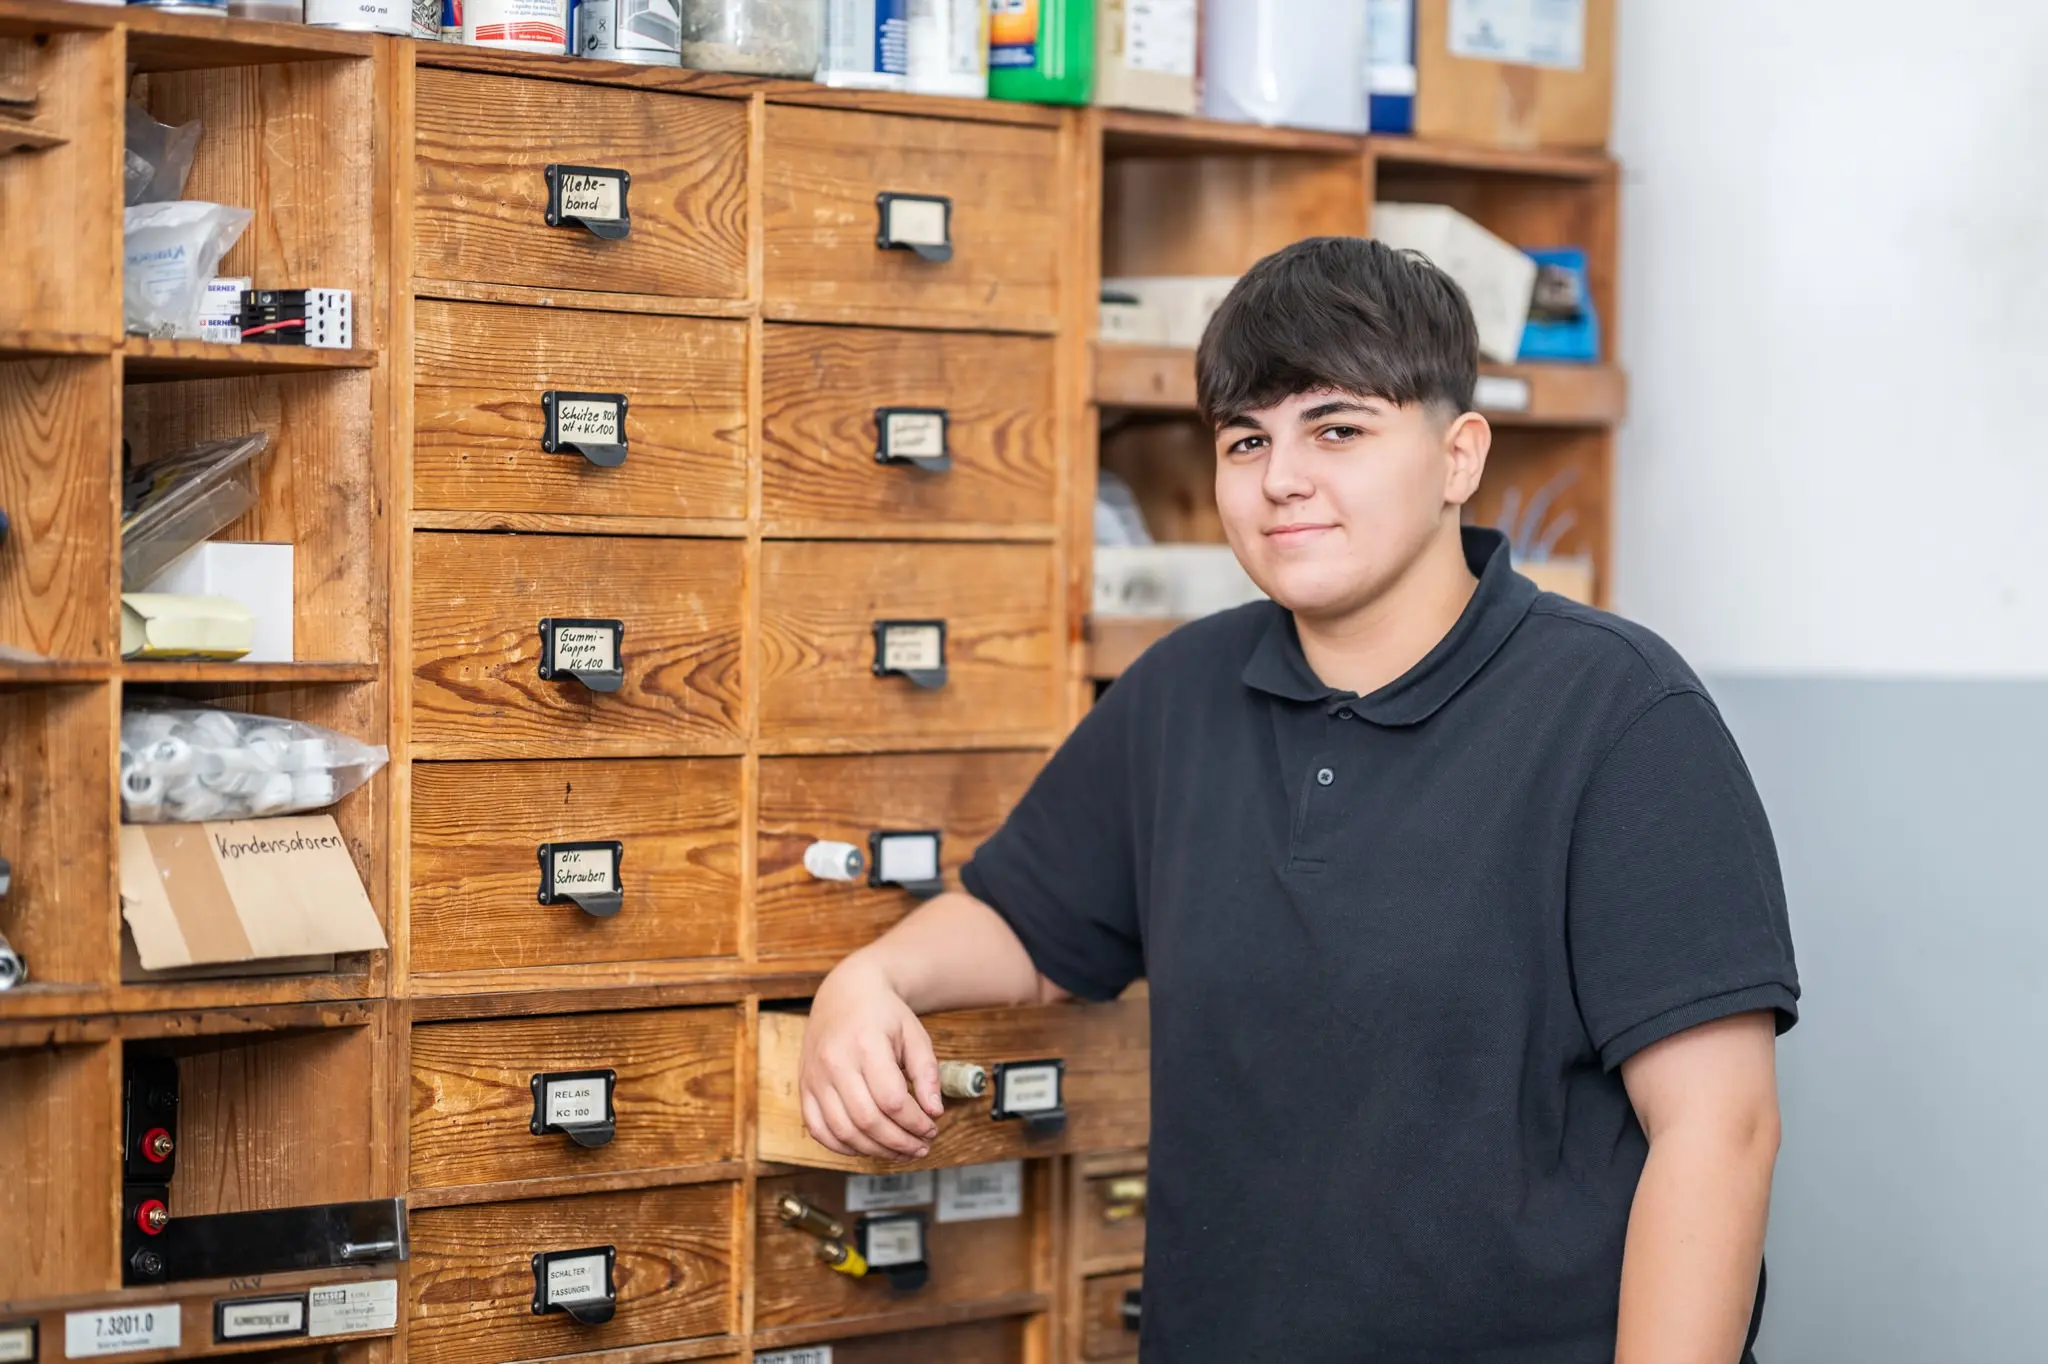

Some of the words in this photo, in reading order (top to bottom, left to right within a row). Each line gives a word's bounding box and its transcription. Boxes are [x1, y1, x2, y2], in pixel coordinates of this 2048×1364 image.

[359, 5, 376, 13] 400
[561, 174, 606, 193] Klebe-
[565, 195, 599, 210] band
[560, 406, 600, 422] Schütze
[596, 423, 614, 435] 100
[584, 658, 604, 670] 100
[215, 830, 341, 859] Kondensatoren
[555, 869, 606, 884] Schrauben
[555, 1090, 590, 1099] RELAIS
[556, 1109, 571, 1118] KC
[574, 1108, 590, 1116] 100
[550, 1267, 586, 1279] SCHALTER
[551, 1285, 590, 1297] FASSUNGEN
[95, 1313, 154, 1337] 7.3201.0
